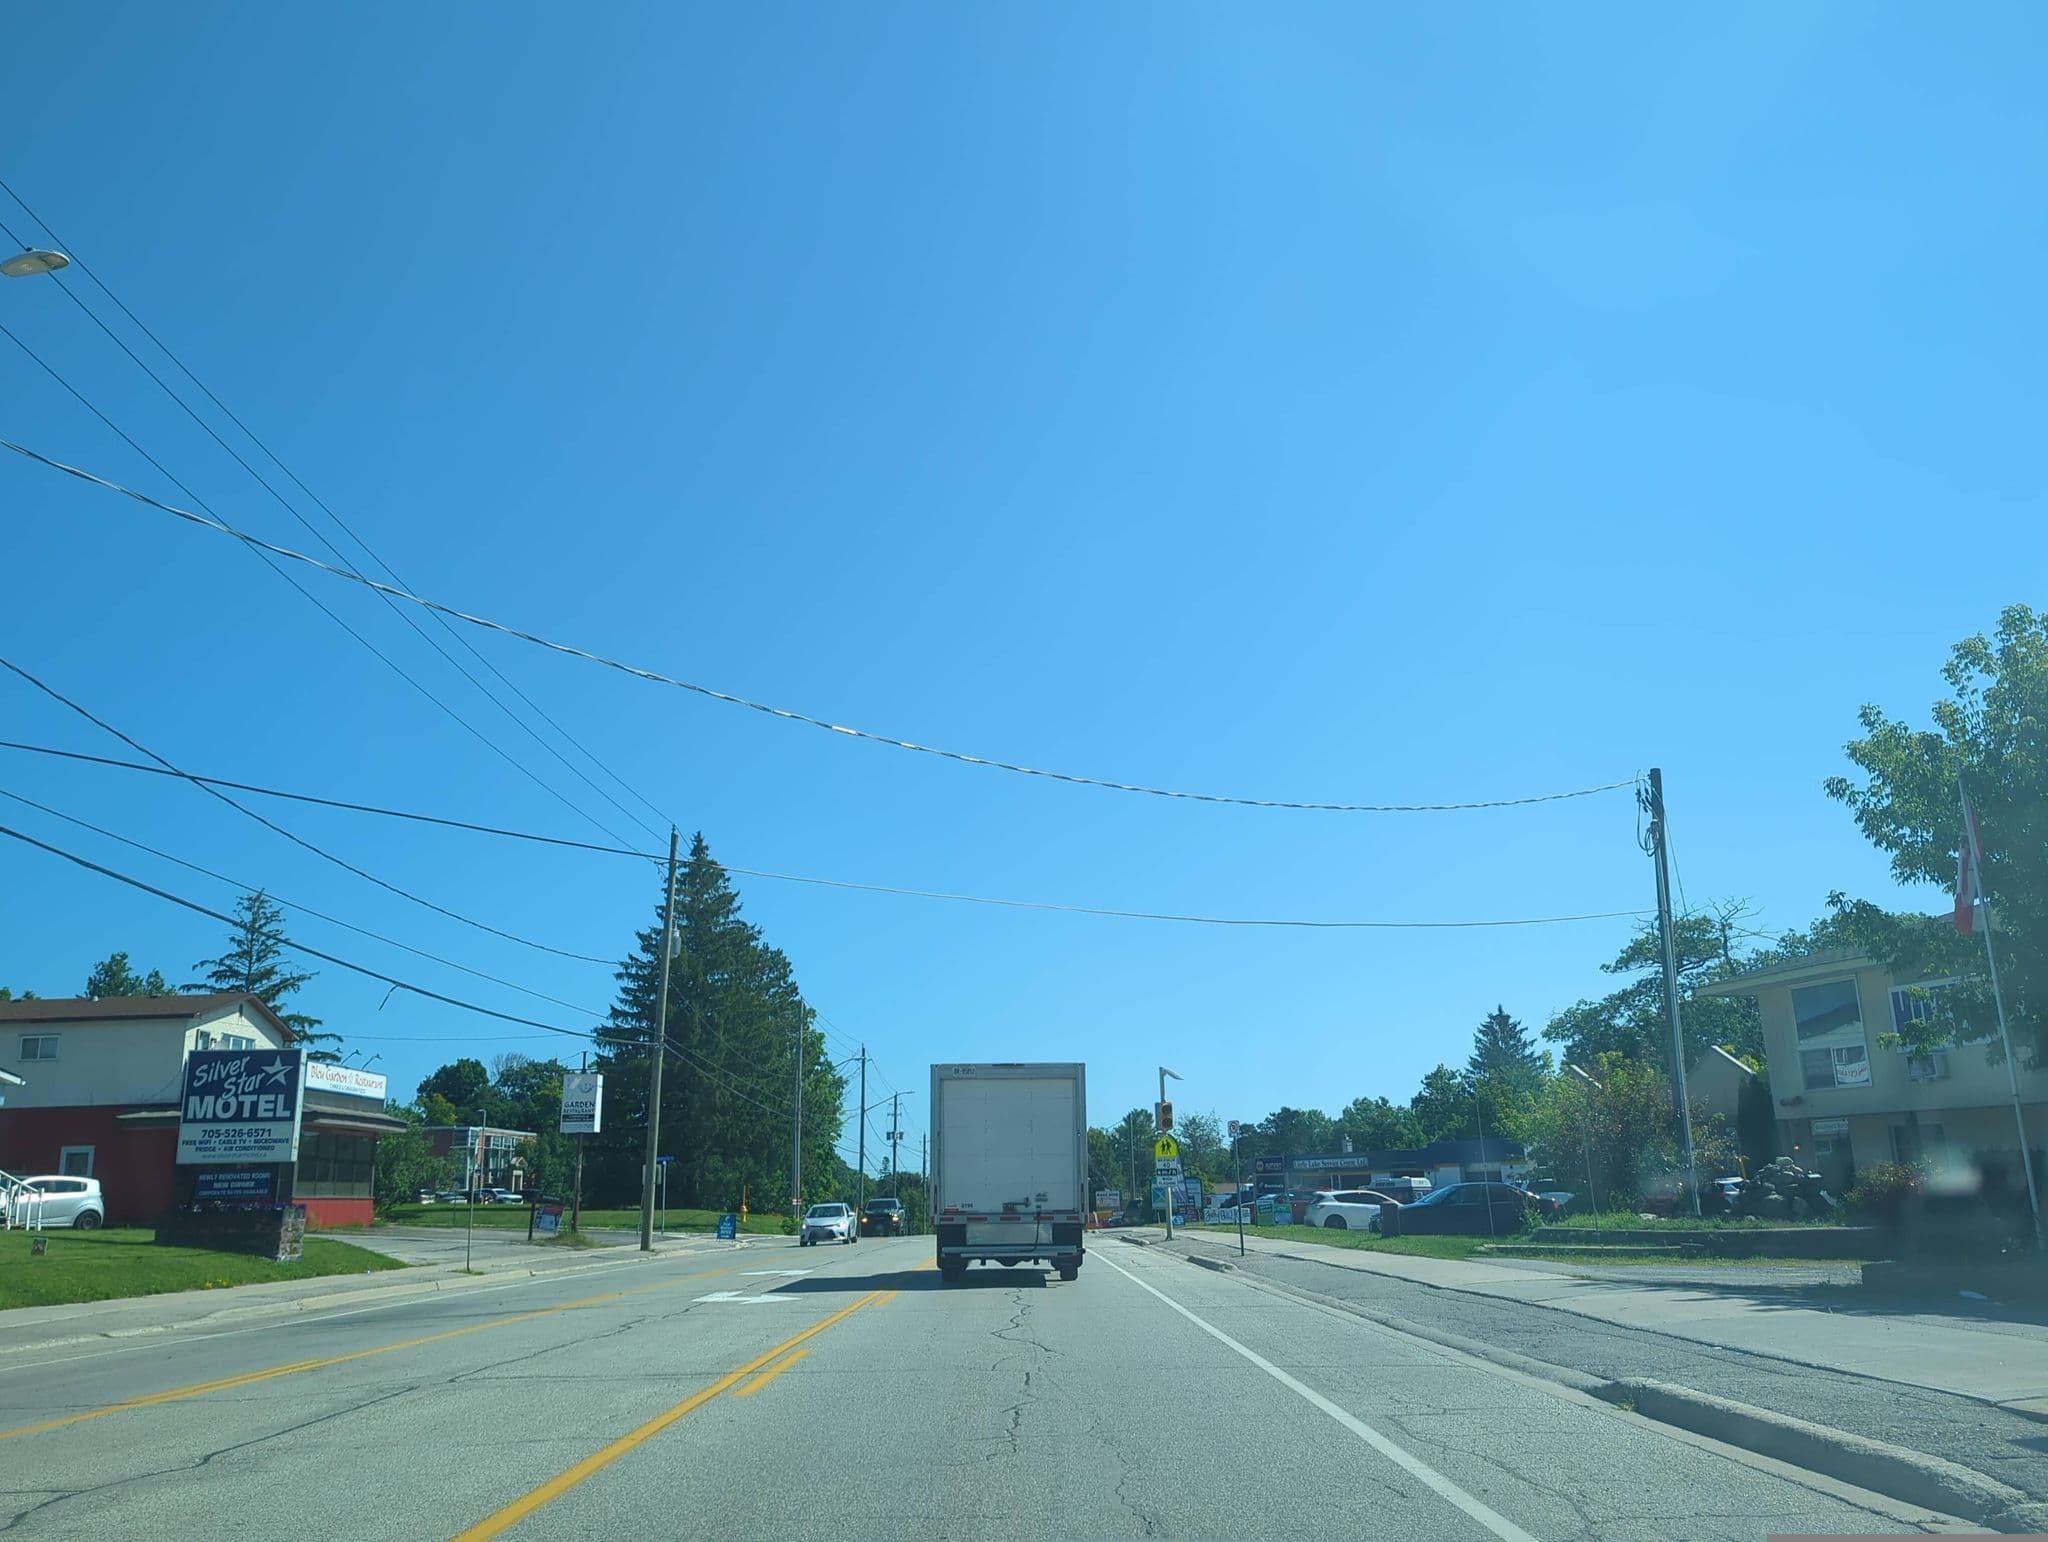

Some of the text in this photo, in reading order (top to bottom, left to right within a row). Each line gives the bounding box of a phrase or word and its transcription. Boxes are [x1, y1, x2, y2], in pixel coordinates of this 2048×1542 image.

[193, 1056, 251, 1087] Silver
[222, 1072, 266, 1099] Star
[187, 1094, 292, 1119] MOTEL
[201, 1128, 272, 1138] 705-526-6571
